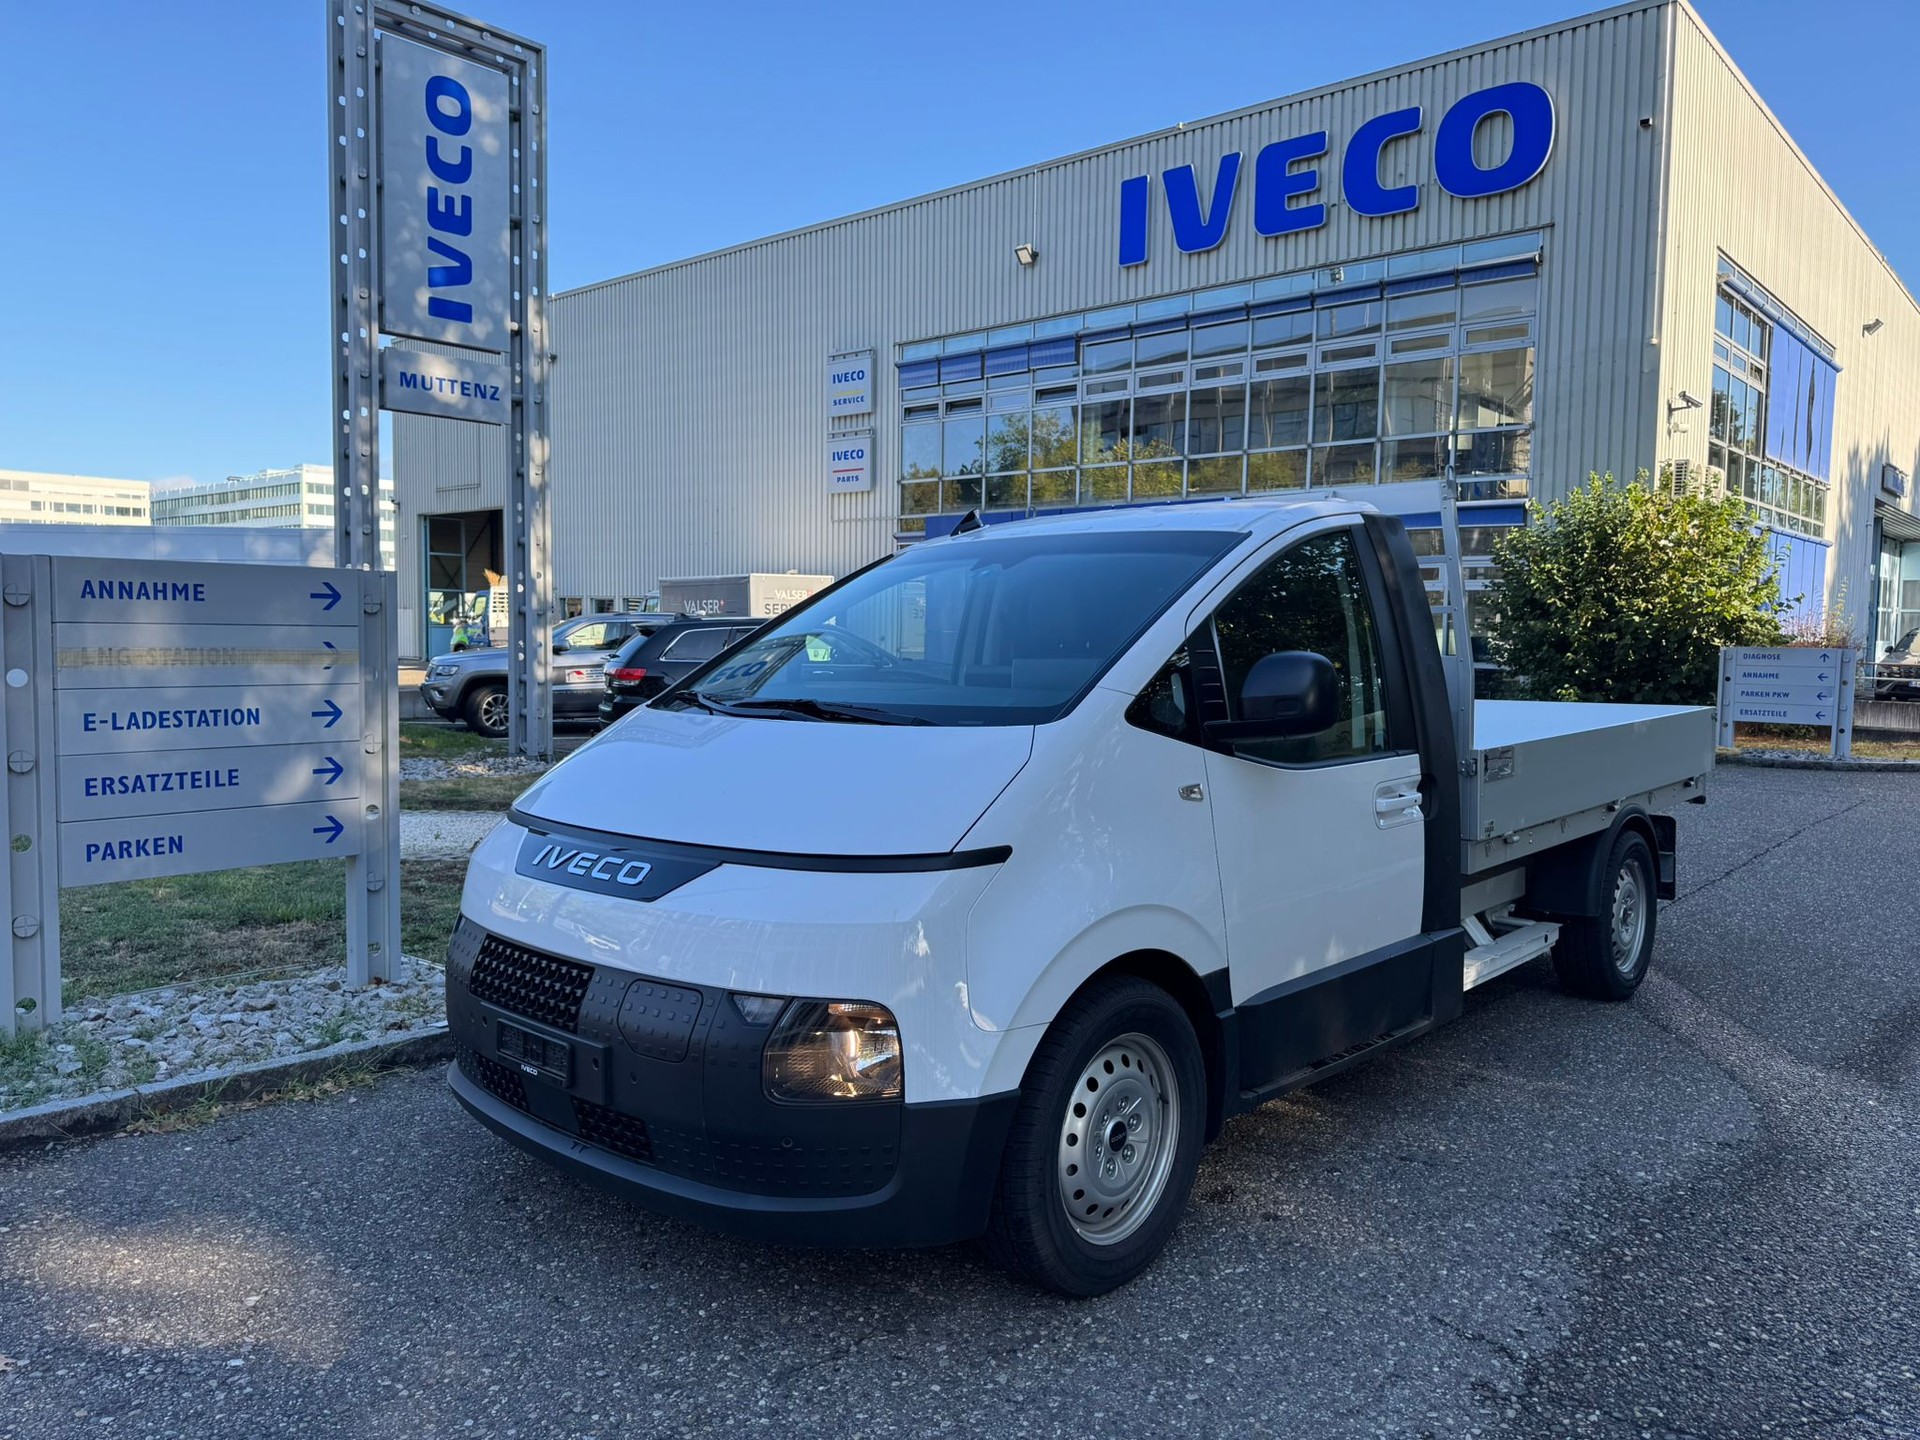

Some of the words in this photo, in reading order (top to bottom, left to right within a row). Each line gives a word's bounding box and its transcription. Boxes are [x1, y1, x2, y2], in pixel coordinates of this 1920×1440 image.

[1118, 81, 1556, 268] IVECO
[425, 75, 472, 324] IVECO
[399, 371, 500, 401] MUTTENZ
[832, 369, 865, 384] IVECO
[833, 395, 865, 406] SERVICE
[832, 448, 864, 461] IVECO
[837, 475, 859, 483] PARTS
[80, 579, 206, 602] ANNAHME
[684, 600, 720, 614] VALSER
[1740, 690, 1770, 698] PARKEN
[83, 707, 261, 732] E-LADESTATION
[1739, 708, 1788, 717] ERSATZTEILE
[84, 768, 240, 797] ERSATZTEILE
[85, 835, 184, 862] PARKEN
[532, 844, 652, 886] IVECO
[520, 1064, 538, 1075] IVECO
